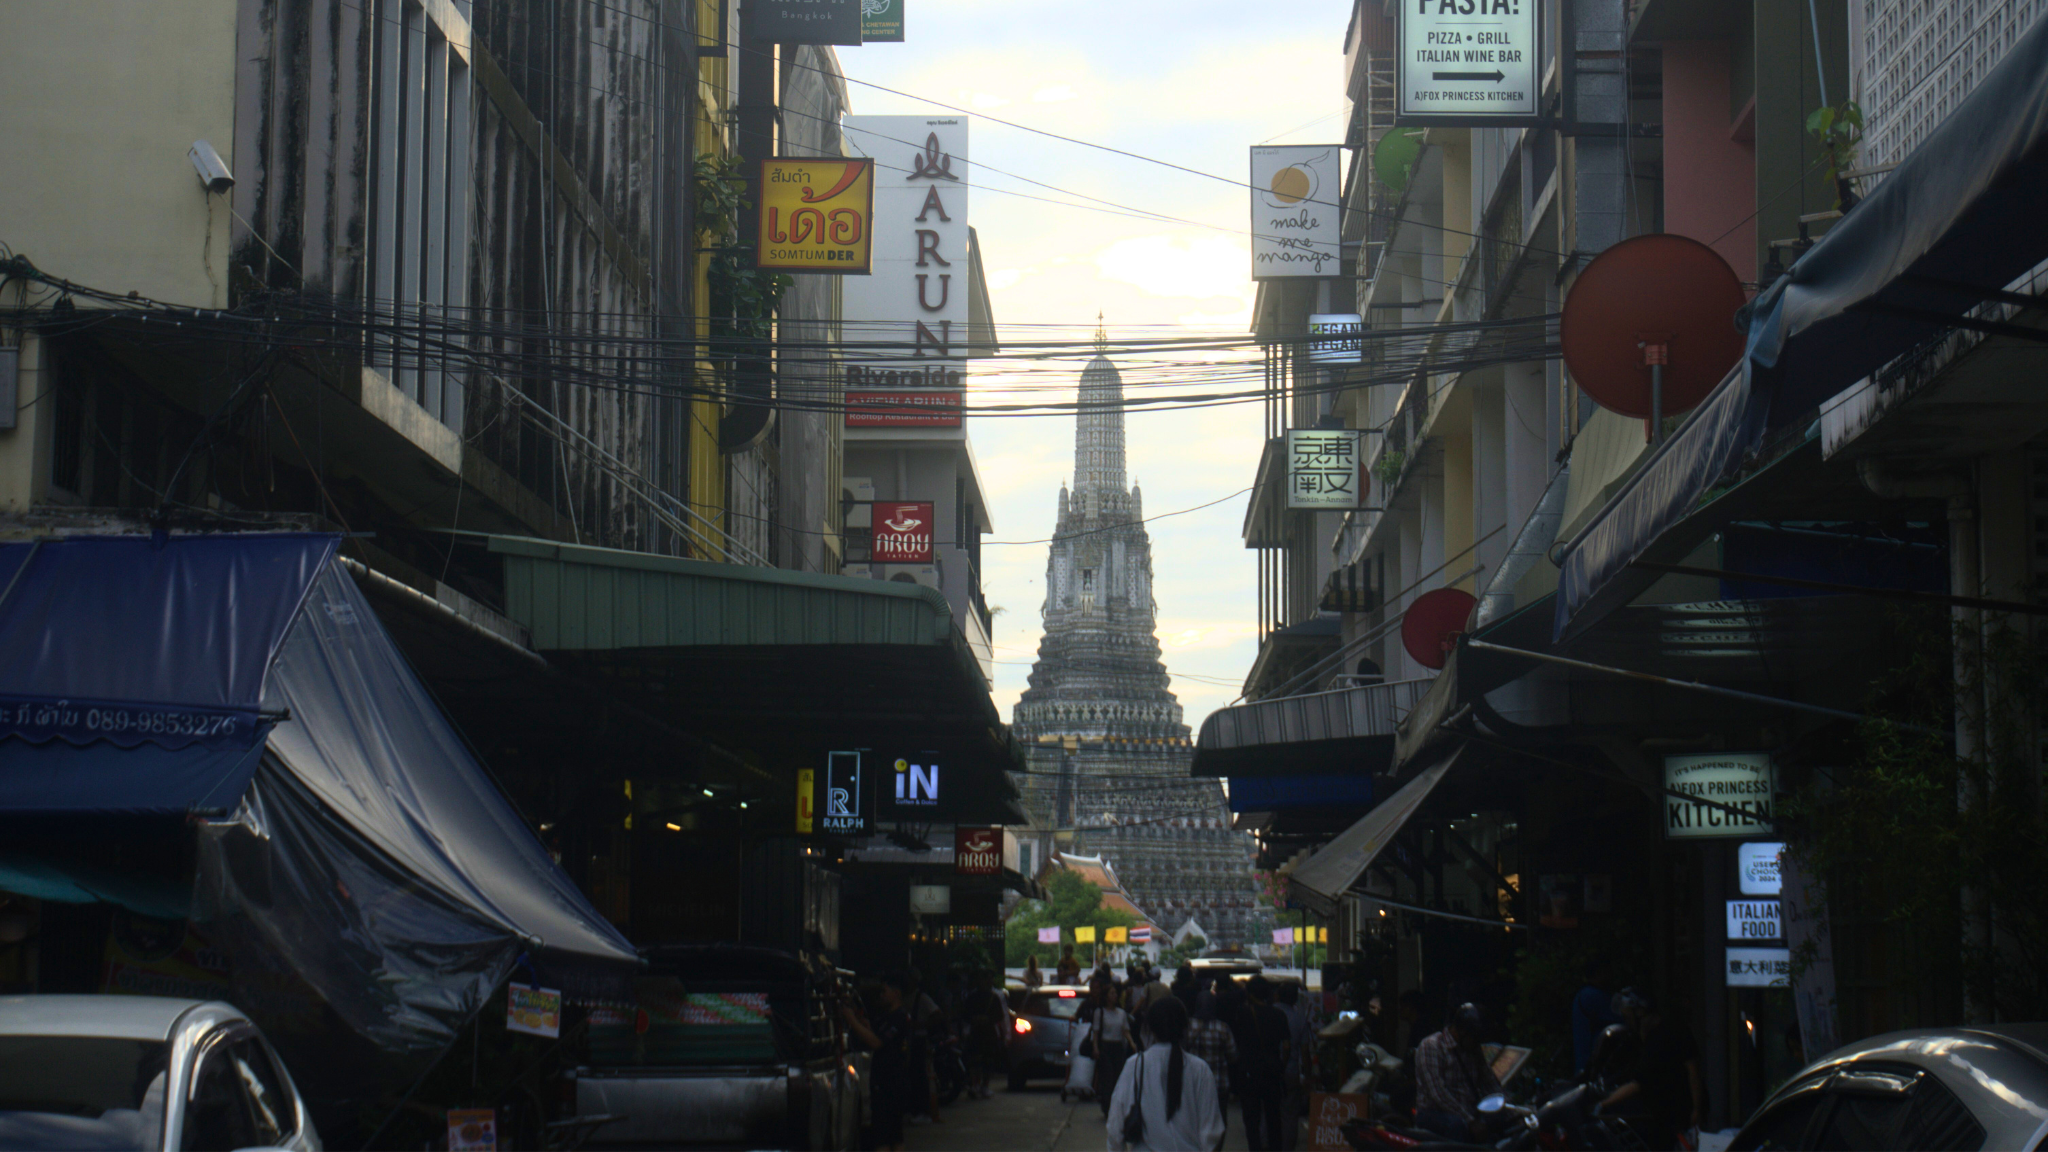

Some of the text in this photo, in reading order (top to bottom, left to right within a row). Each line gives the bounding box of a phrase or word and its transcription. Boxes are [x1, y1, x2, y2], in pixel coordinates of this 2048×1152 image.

[781, 10, 832, 21] Bangkok
[1427, 32, 1511, 44] PIZZA GRILL
[1416, 50, 1522, 62] ITALIAN WINE BAR
[1414, 91, 1524, 102] A)FOX PRINCESS KITCHEN
[771, 168, 811, 183] ส้มตำ
[768, 182, 864, 246] เด้อ
[1270, 208, 1320, 230] make
[1278, 238, 1313, 249] me
[913, 184, 952, 357] ARUN
[1256, 252, 1335, 273] mango
[847, 366, 960, 387] Riverside
[876, 533, 929, 553] AROY
[86, 708, 236, 736] 089-9853276
[1690, 761, 1735, 772] HAPPENED
[1736, 763, 1748, 771] TO
[1707, 780, 1769, 795] PRINCESS
[1669, 800, 1770, 829] KITCHEN
[823, 818, 864, 829] RALPH
[958, 851, 1000, 868] AROY
[1733, 903, 1781, 919] ITALIAN
[1742, 921, 1776, 937] FOOD
